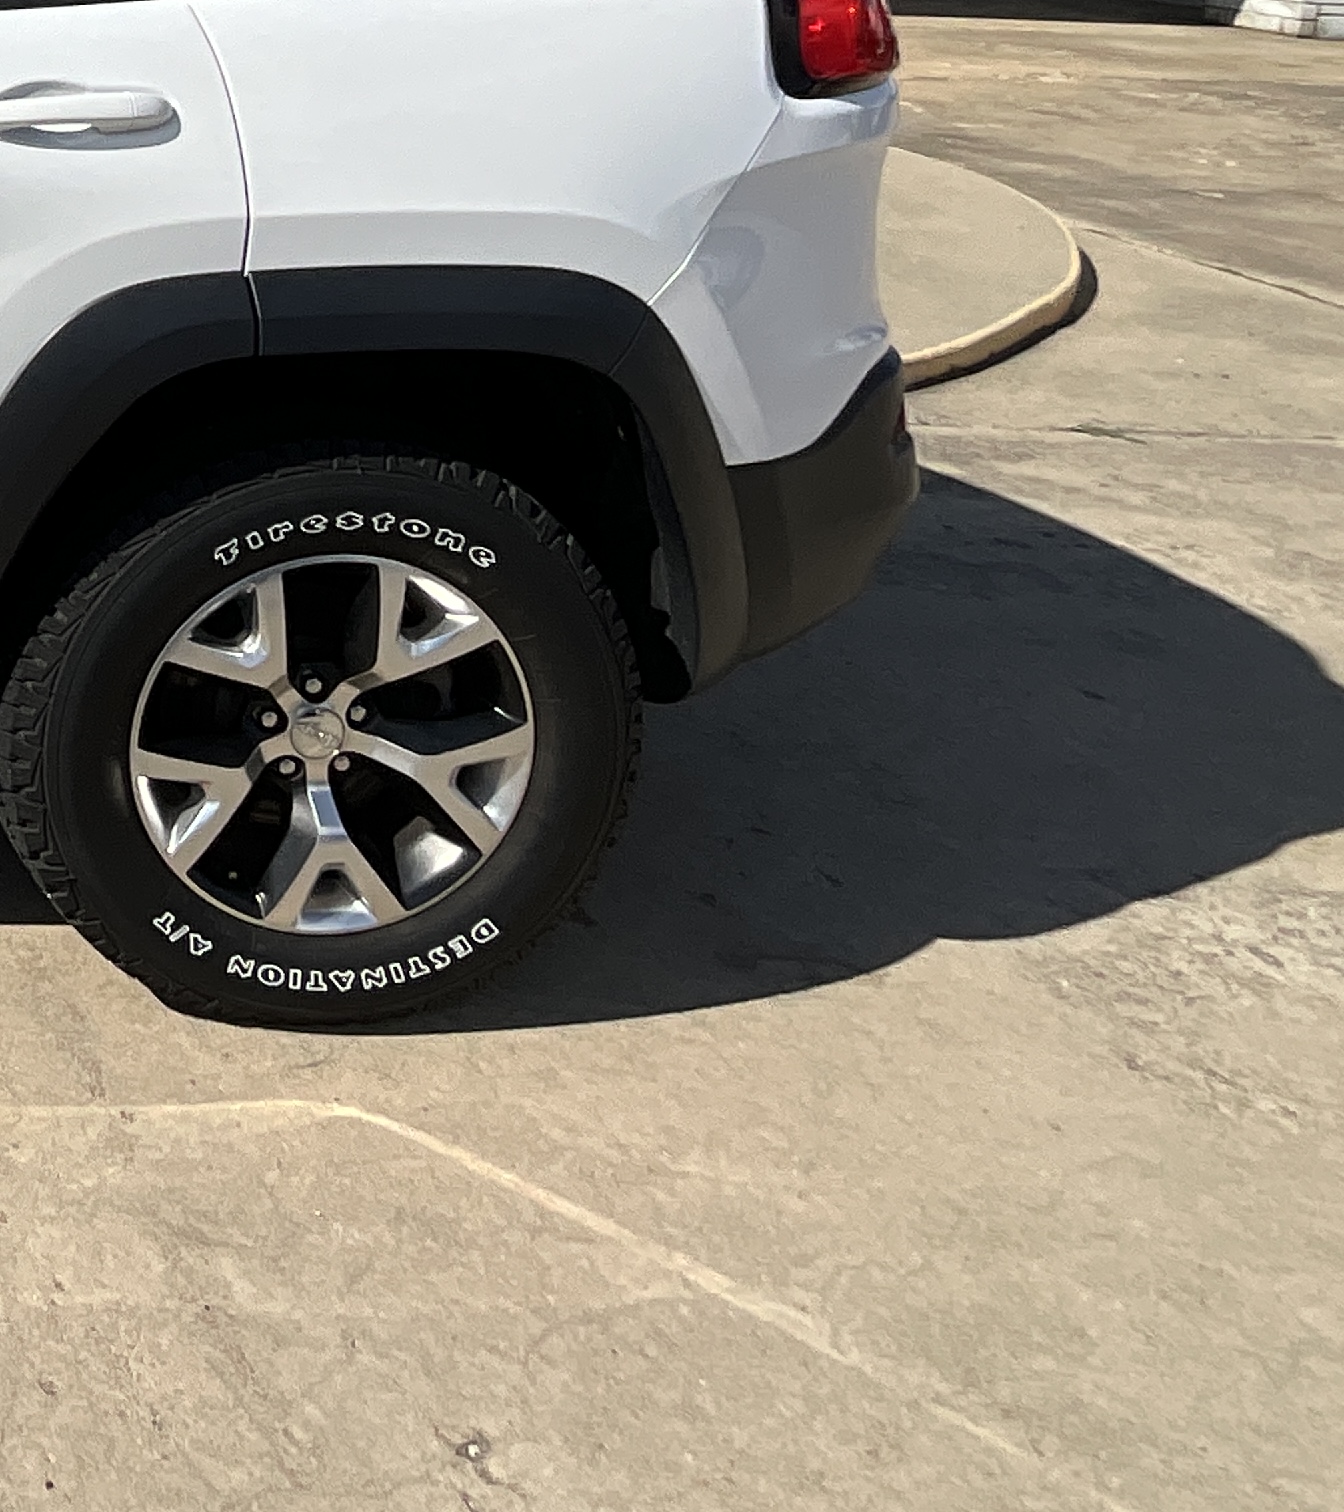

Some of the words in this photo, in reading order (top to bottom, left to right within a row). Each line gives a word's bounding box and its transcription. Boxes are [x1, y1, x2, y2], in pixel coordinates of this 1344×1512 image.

[214, 510, 497, 569] Firestone
[152, 910, 214, 957] A/T
[226, 917, 502, 993] DESTINATION
